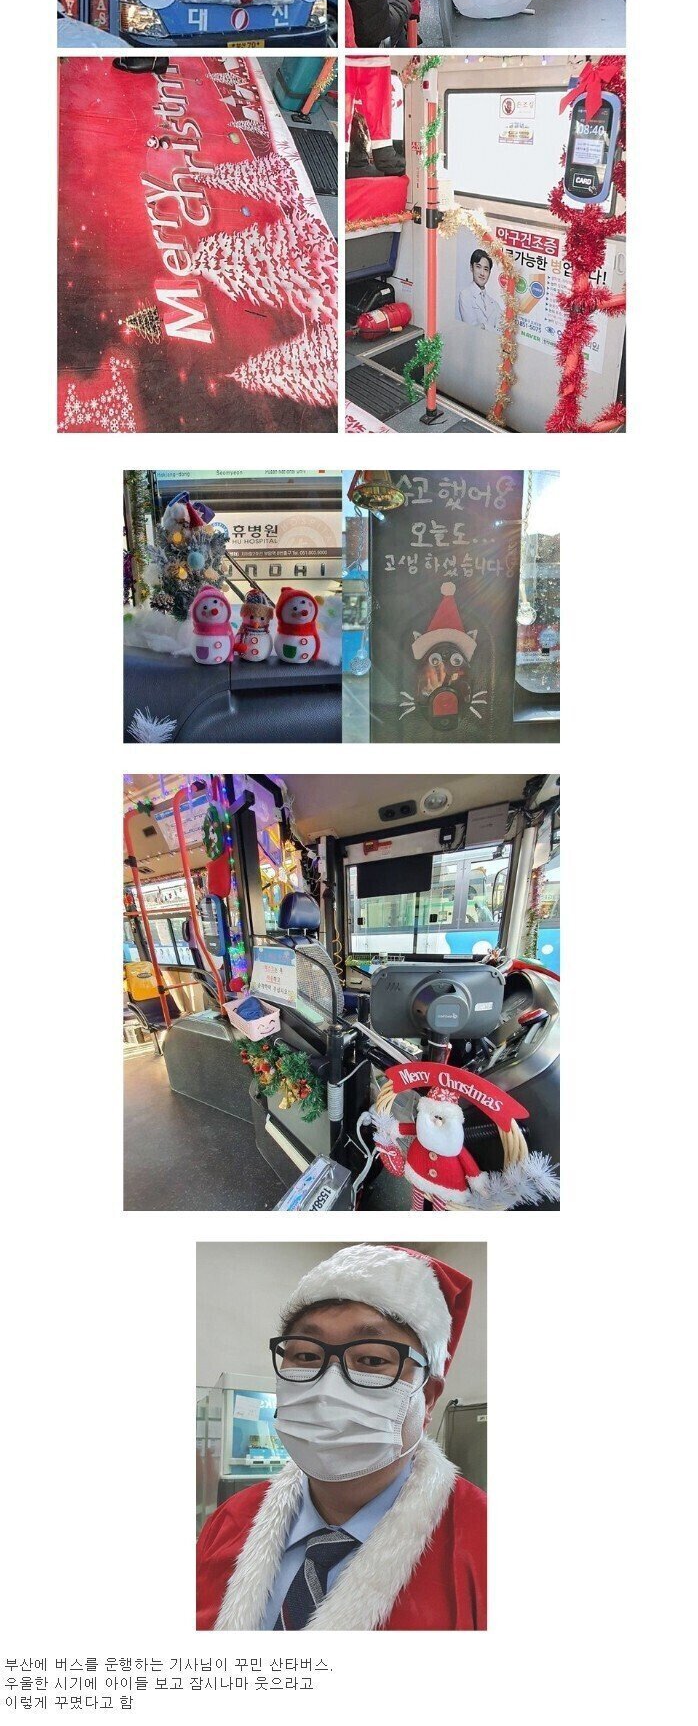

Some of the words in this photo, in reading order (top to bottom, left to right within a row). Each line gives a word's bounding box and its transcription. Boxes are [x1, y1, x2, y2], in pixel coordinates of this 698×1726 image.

[575, 177, 592, 186] CARD
[141, 174, 214, 344] Merry
[521, 330, 541, 342] NAVER
[232, 524, 278, 538] 휴병원
[384, 552, 418, 575] 고생
[399, 1068, 431, 1085] Merry
[438, 1071, 504, 1112] Christmas
